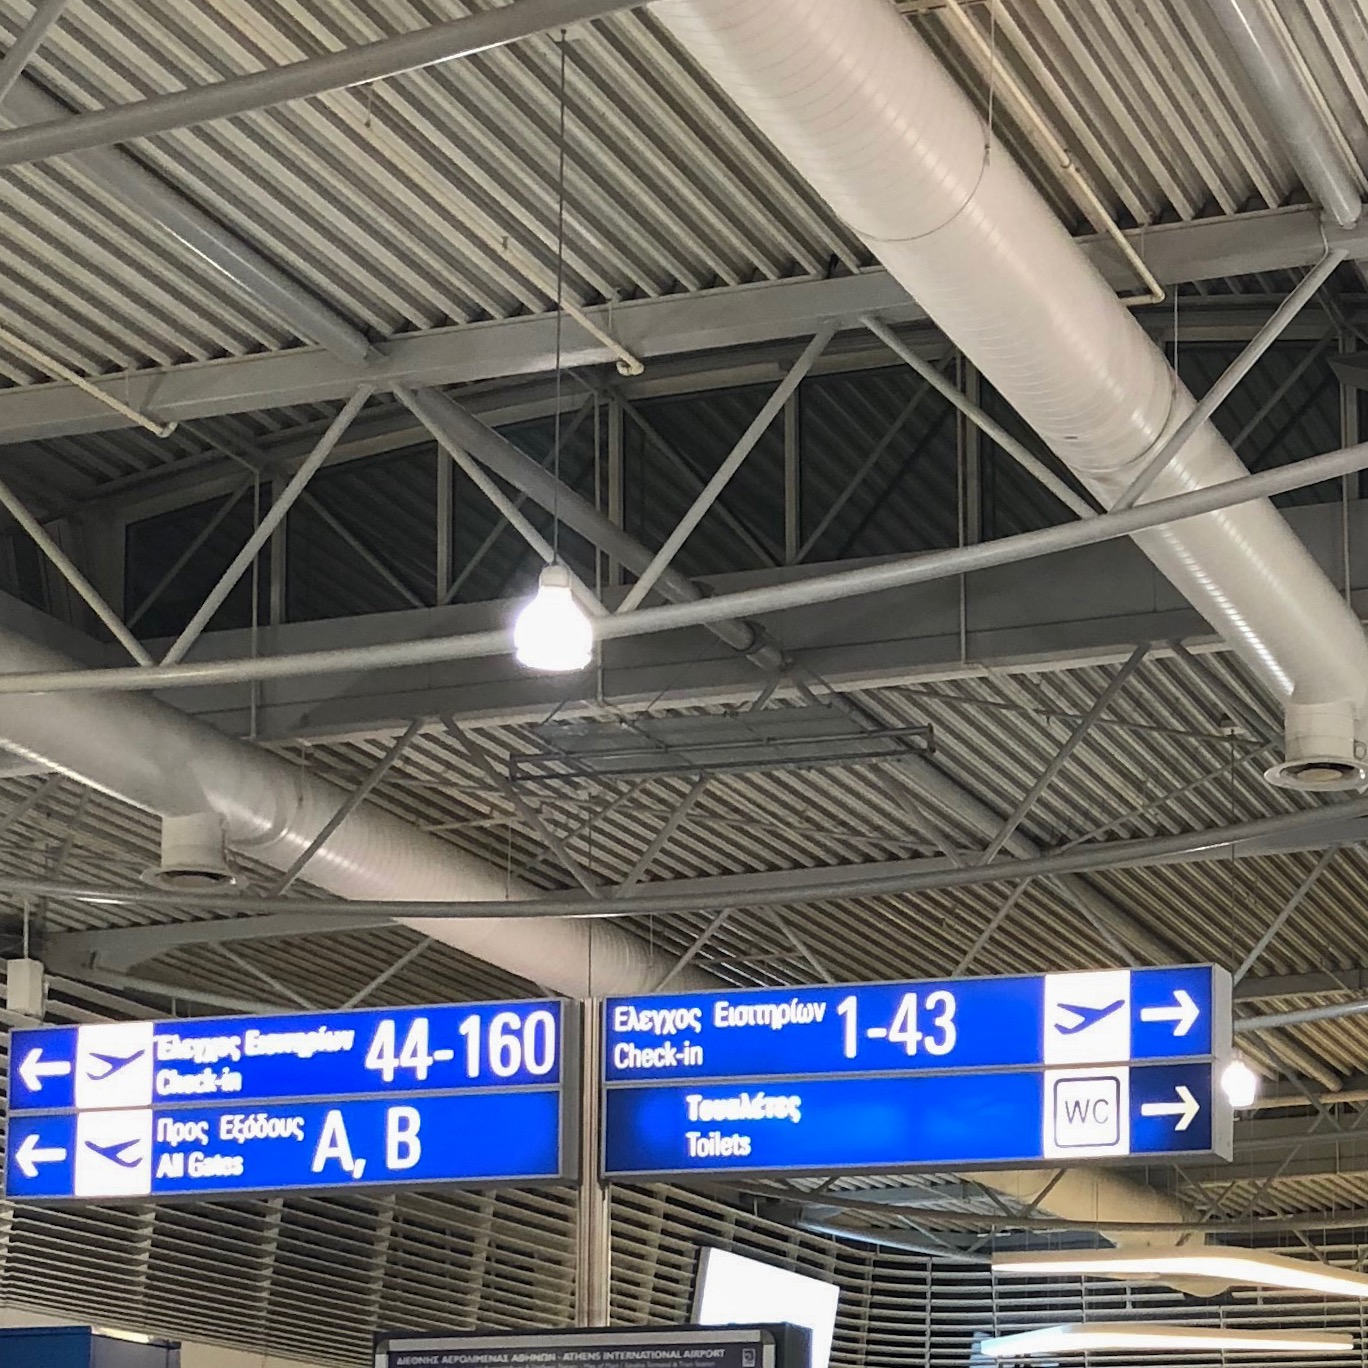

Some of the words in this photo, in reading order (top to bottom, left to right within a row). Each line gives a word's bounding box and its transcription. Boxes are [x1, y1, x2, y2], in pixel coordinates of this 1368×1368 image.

[836, 990, 958, 1060] 1-43
[365, 1009, 557, 1082] 44-160
[614, 1041, 704, 1069] Check-in
[156, 1066, 243, 1095] Check-in
[1065, 1097, 1110, 1126] WC
[157, 1117, 209, 1147] Προς
[219, 1113, 305, 1144] Εξόδους
[386, 1106, 422, 1170] B
[685, 1131, 751, 1158] Toilets
[156, 1152, 184, 1179] All
[187, 1150, 244, 1178] Gates
[563, 1351, 601, 1362] ATHENS
[603, 1349, 682, 1361] INTERNATIONAL
[683, 1348, 726, 1359] AIRPORT
